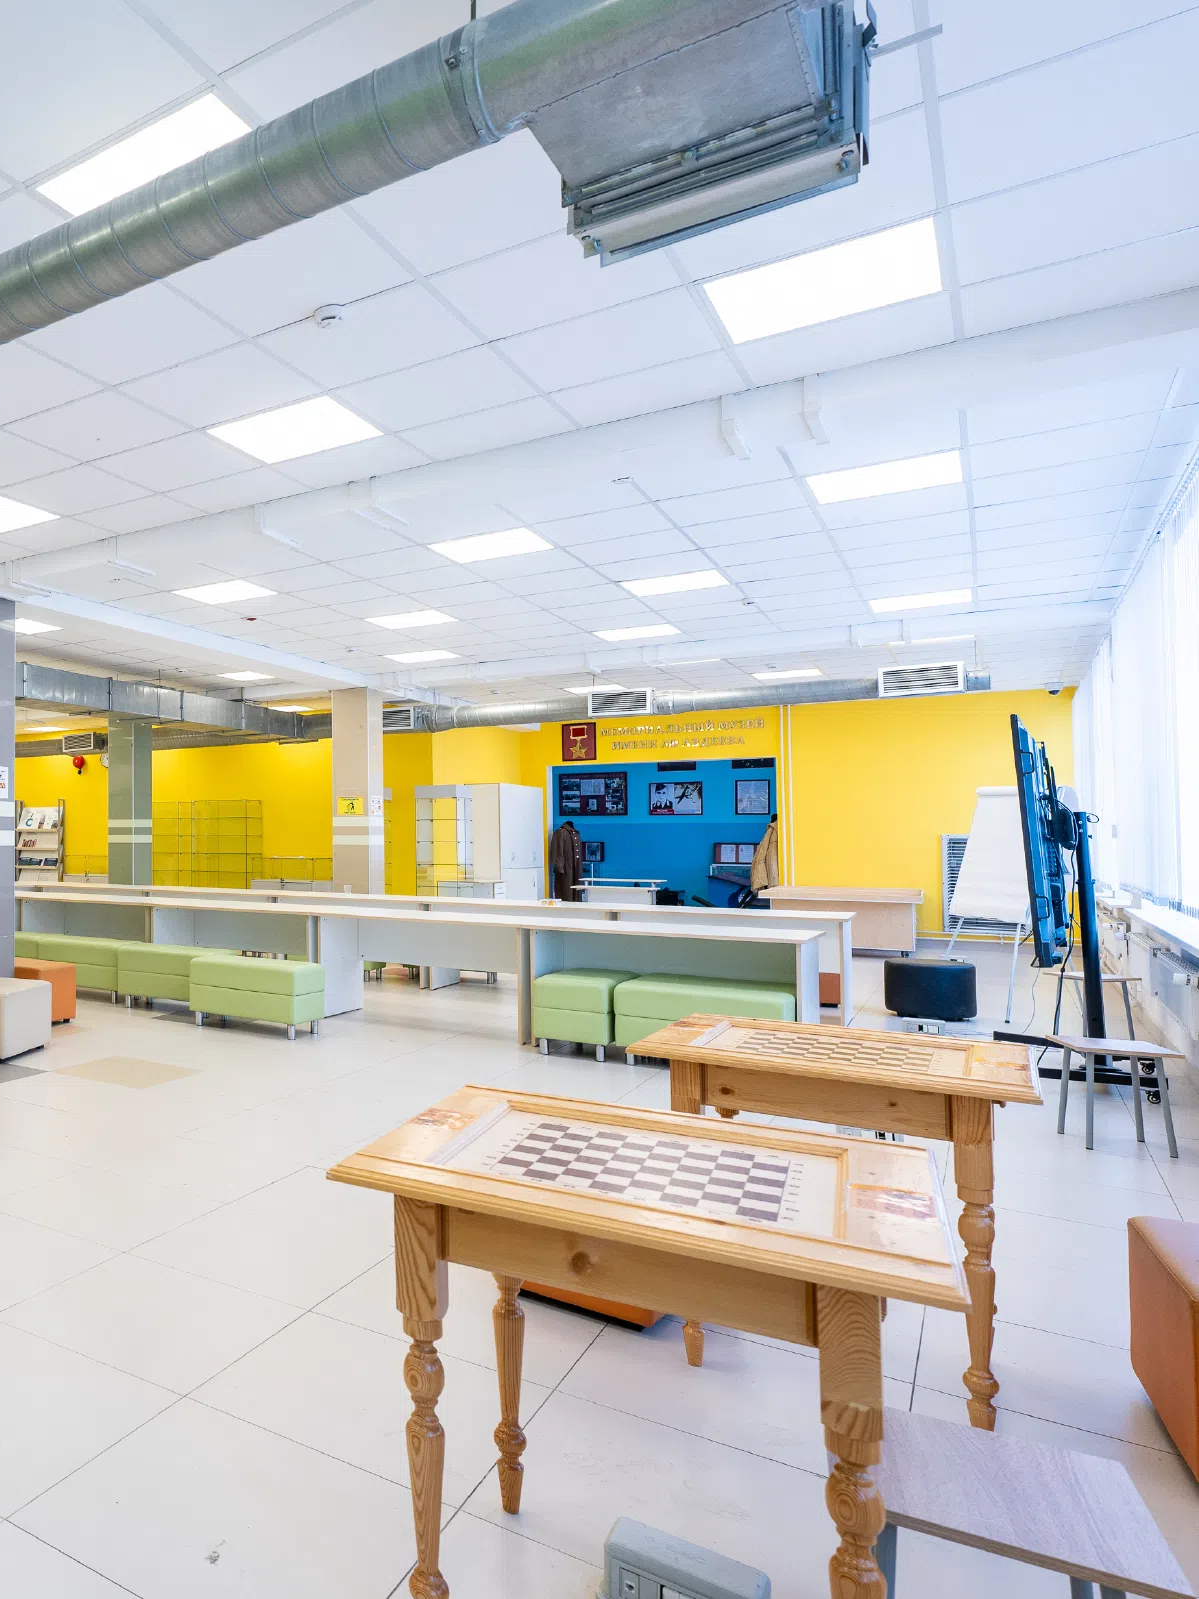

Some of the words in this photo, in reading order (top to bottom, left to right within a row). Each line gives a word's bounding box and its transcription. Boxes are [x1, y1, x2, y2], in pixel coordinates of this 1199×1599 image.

[600, 719, 715, 737] МЕМОРИАЛЬНЫЙ
[718, 717, 765, 732] МУЗЕЙ
[611, 738, 658, 750] ИМЕНИ
[681, 735, 745, 748] АВДЕЕВА
